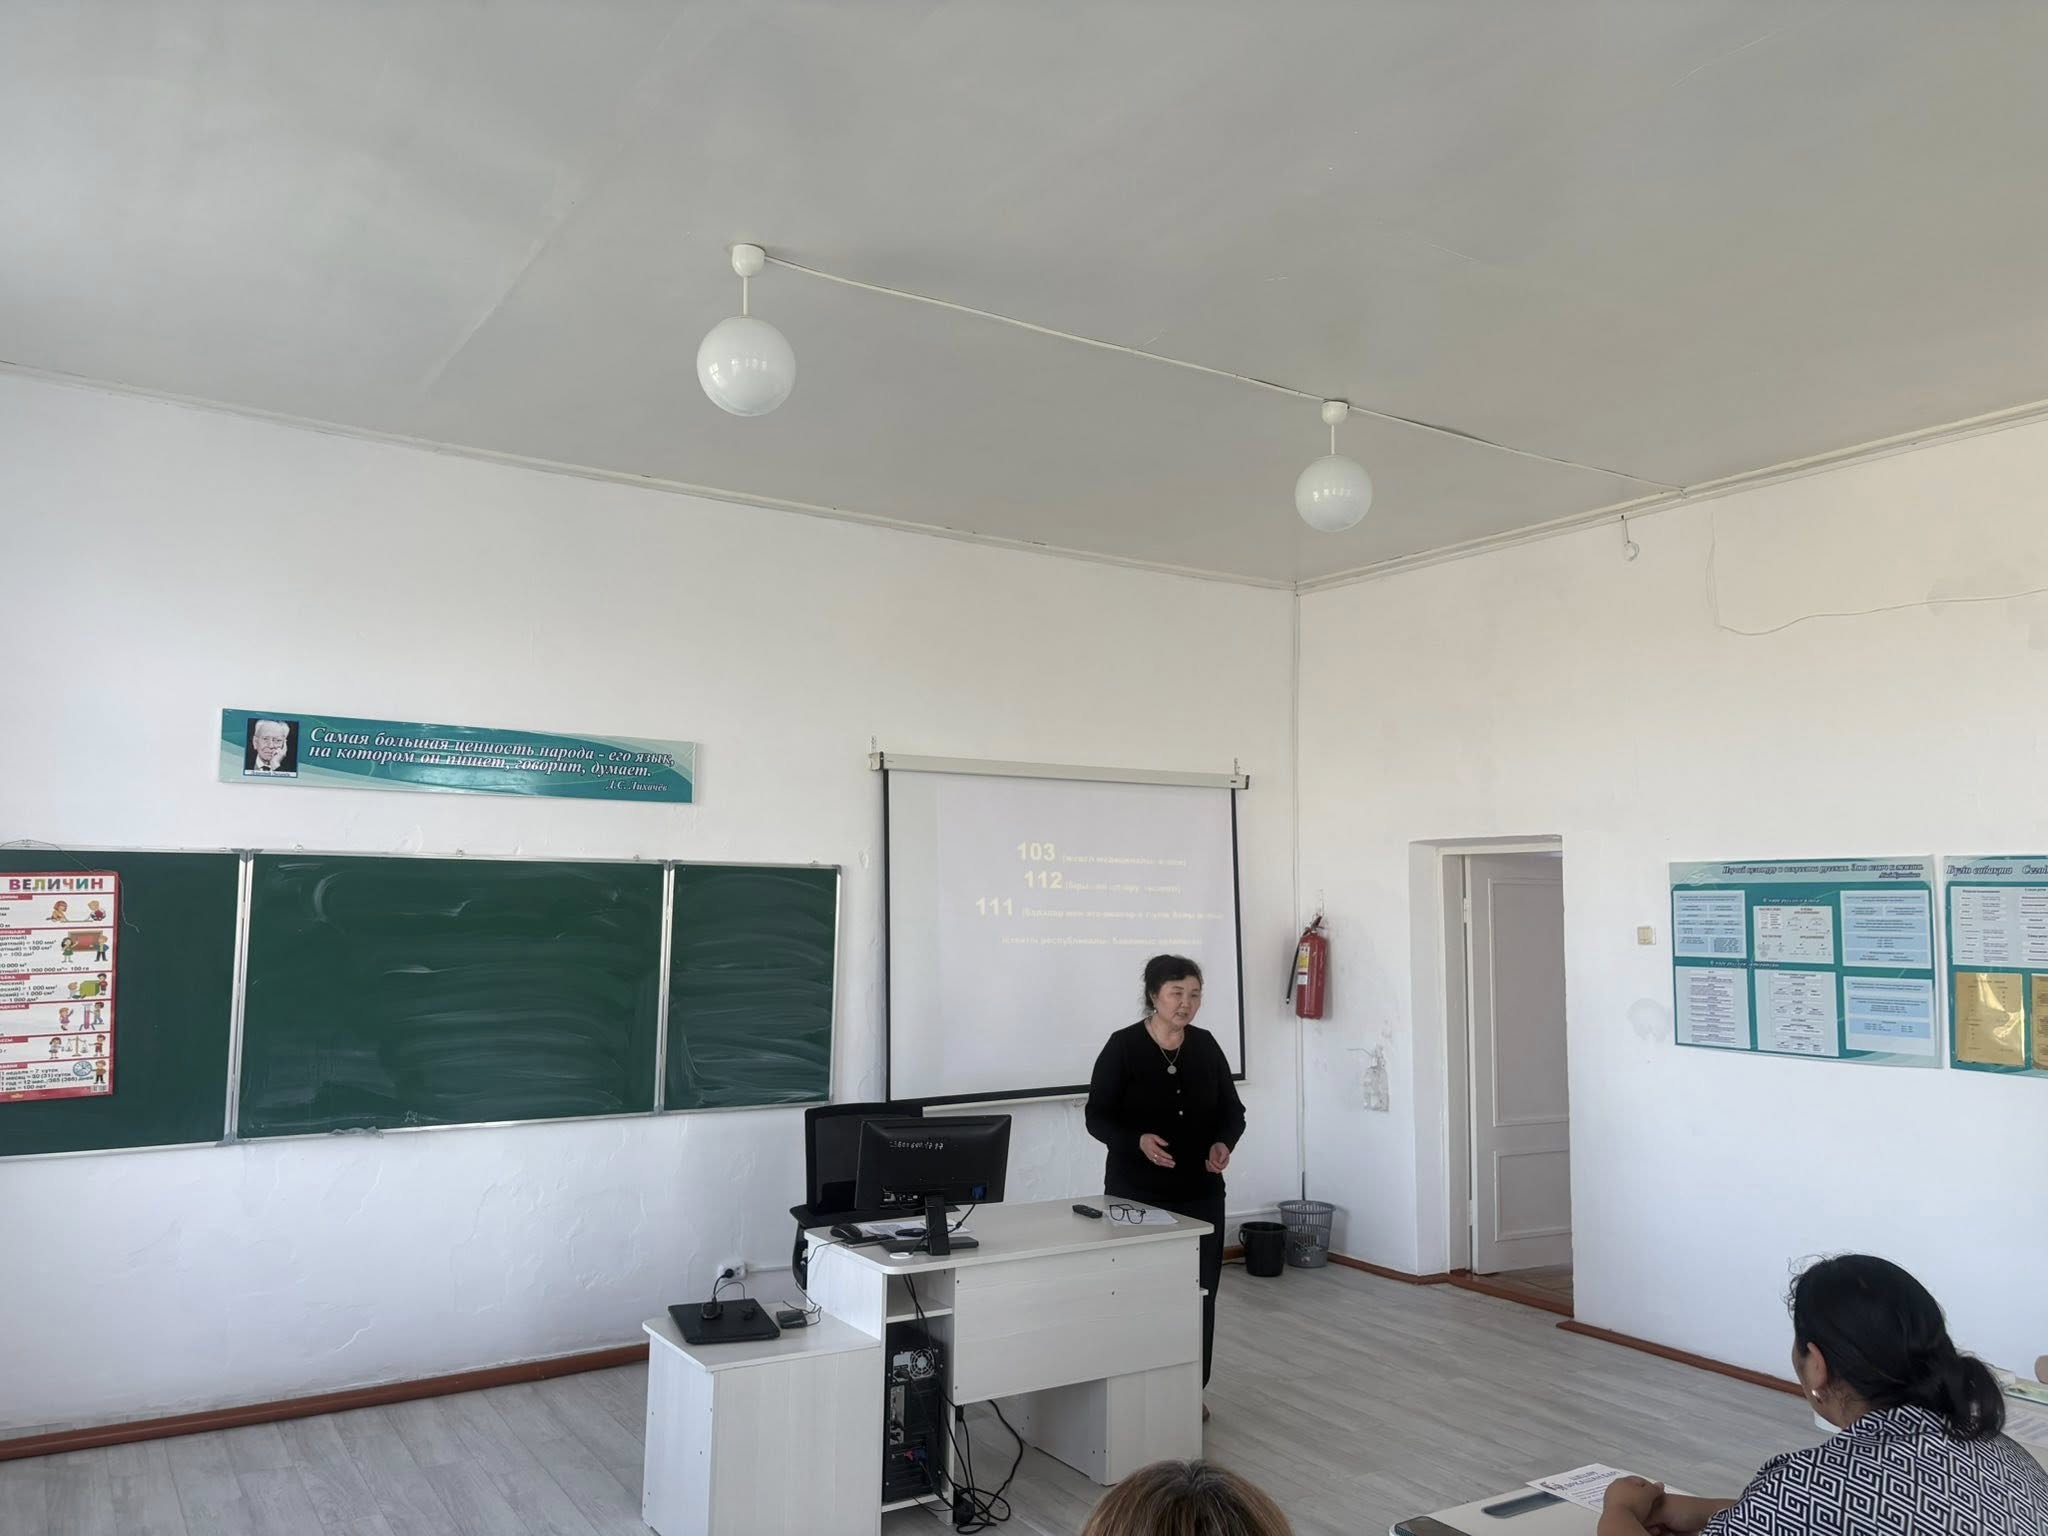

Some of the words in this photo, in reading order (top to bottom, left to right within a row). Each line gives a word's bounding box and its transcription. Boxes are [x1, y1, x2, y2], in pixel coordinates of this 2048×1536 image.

[310, 727, 369, 745] Самая
[374, 732, 449, 750] большая
[455, 740, 534, 756] ценность
[539, 745, 594, 760] народа
[608, 751, 631, 762] его
[635, 753, 675, 766] язык,
[309, 745, 330, 757] на
[336, 748, 415, 764] котором
[420, 754, 441, 764] он
[446, 755, 510, 769] пишет,
[515, 758, 586, 775] говорит,
[590, 762, 651, 777] думает.
[1017, 842, 1055, 861] 103
[9, 878, 103, 891] ВЕЛИЧИН
[1024, 871, 1063, 889] 112
[975, 897, 1014, 916] 111
